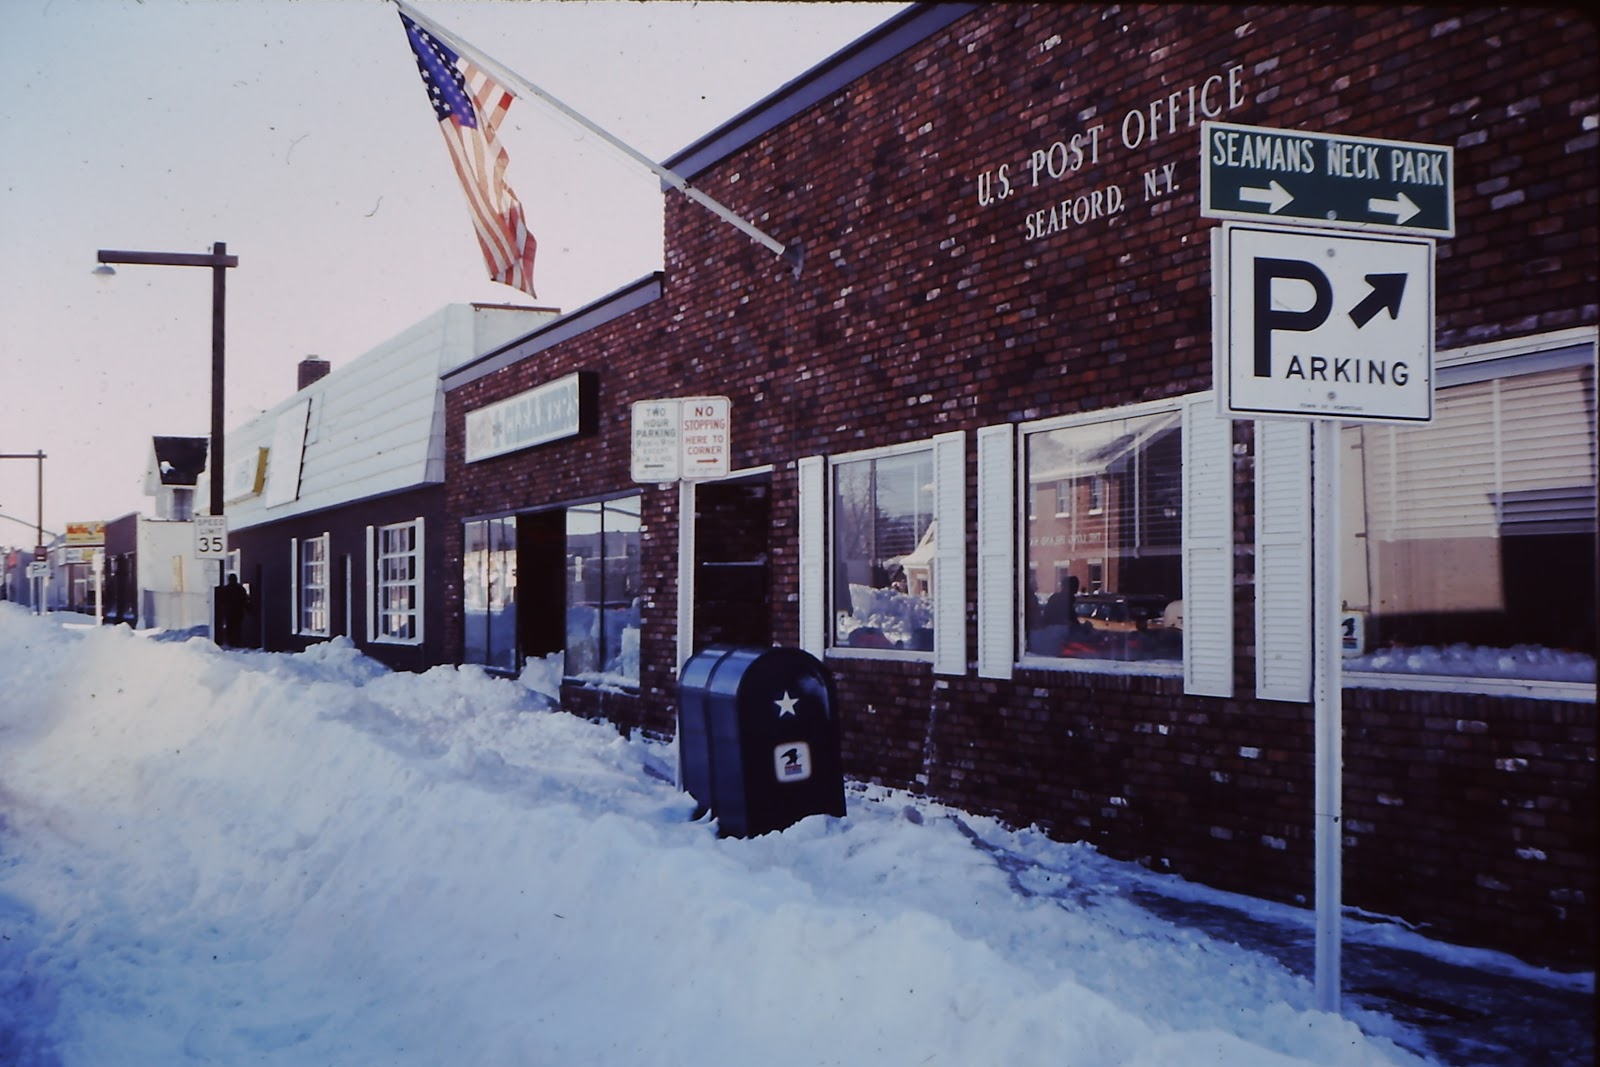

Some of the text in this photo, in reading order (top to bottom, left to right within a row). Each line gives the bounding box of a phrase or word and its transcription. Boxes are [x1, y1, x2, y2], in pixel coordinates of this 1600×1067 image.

[978, 64, 1245, 206] U.S. POST OFFICE
[1213, 131, 1444, 186] SEAMANS NECK PARK
[1144, 162, 1180, 201] N.Y.
[646, 407, 666, 417] TWO
[694, 405, 715, 417] NO
[643, 418, 669, 428] HOUR
[684, 418, 726, 431] STOPPING
[636, 428, 676, 438] PARKING
[685, 434, 724, 445] HERE TO
[687, 445, 723, 456] CORNER
[197, 518, 225, 526] SPEED
[200, 527, 222, 535] LIMIT
[198, 536, 223, 553] 35
